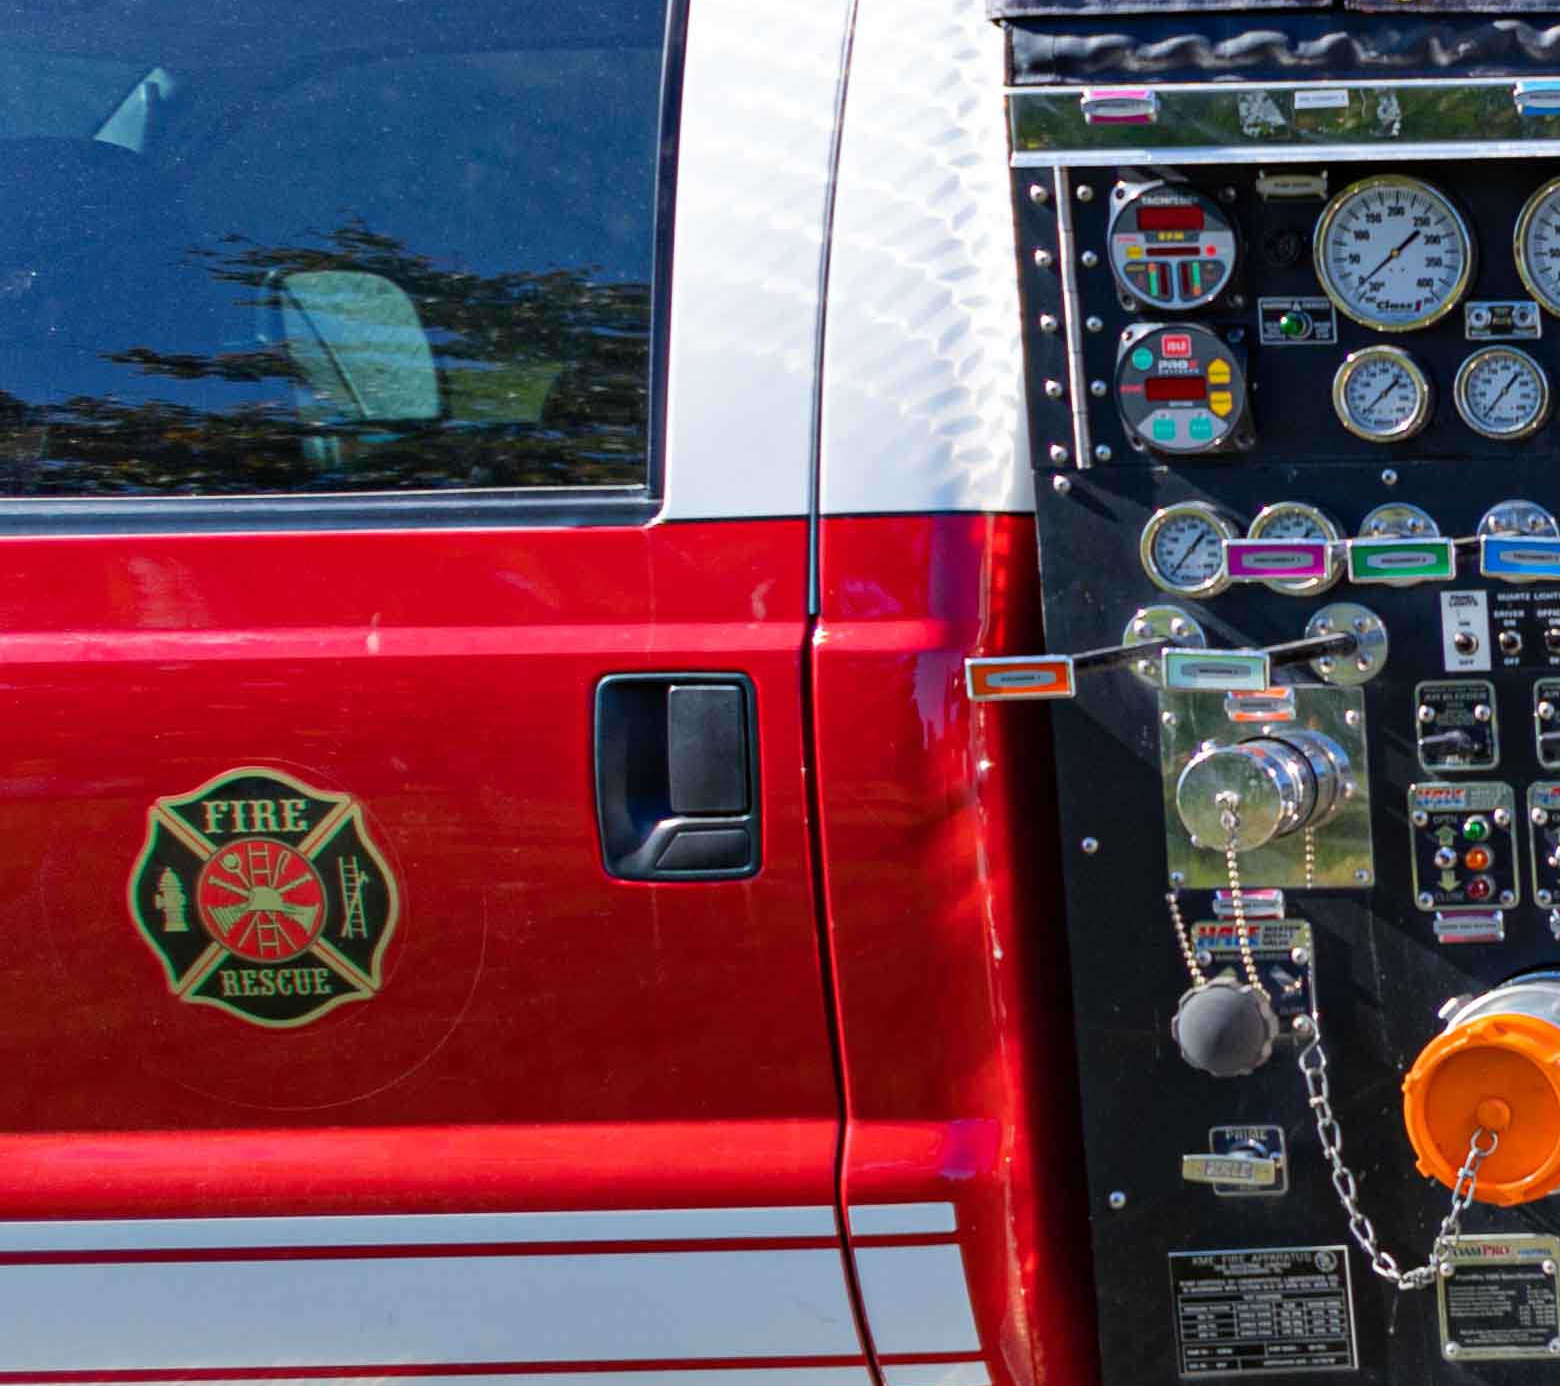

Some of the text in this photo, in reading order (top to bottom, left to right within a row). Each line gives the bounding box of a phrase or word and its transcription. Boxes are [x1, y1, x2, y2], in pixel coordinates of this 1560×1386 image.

[201, 798, 309, 834] FIRE
[1432, 815, 1458, 824] OPEN
[1434, 892, 1464, 901] CLOSE
[219, 967, 333, 997] RESCUE
[1252, 1253, 1312, 1263] APPARATUS
